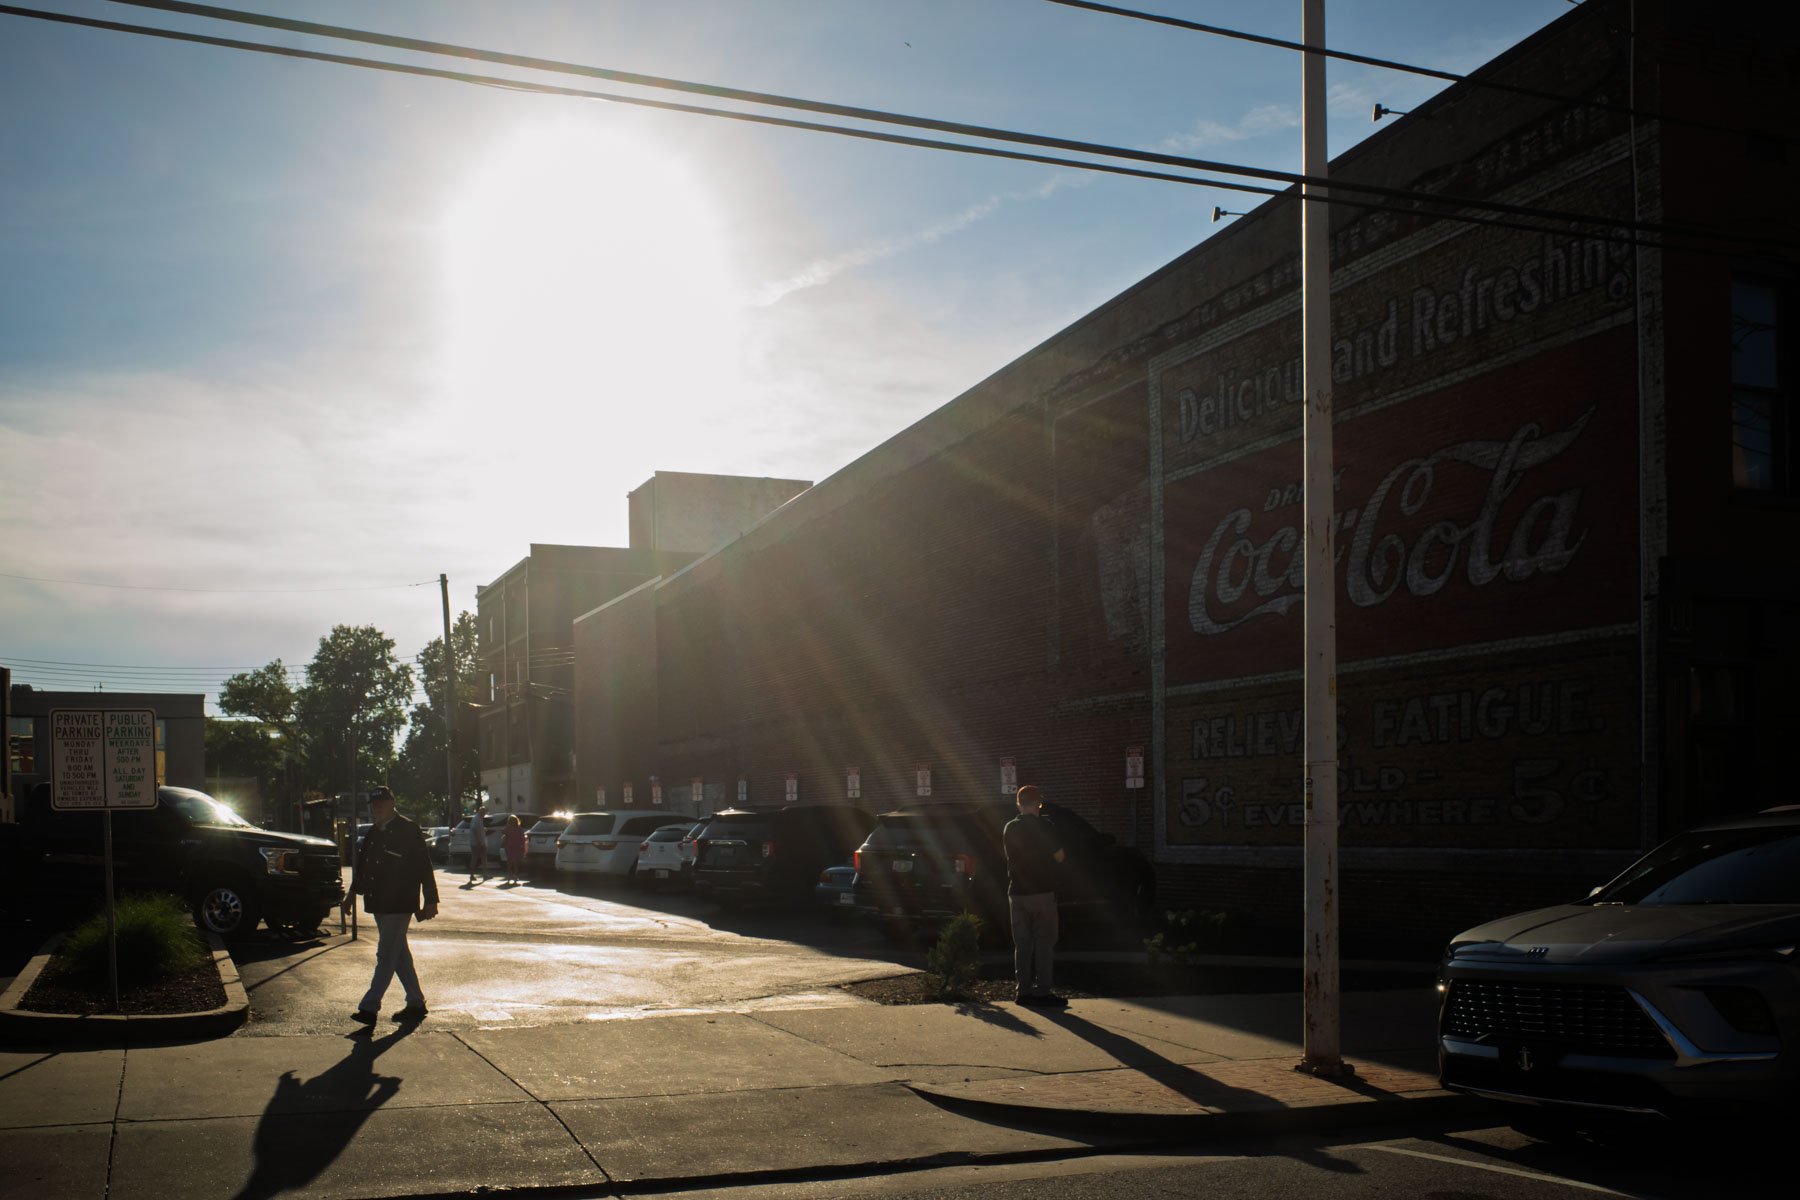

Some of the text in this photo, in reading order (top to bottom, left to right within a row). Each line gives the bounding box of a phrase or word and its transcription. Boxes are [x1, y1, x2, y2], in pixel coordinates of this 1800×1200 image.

[1332, 296, 1399, 386] and
[1411, 220, 1634, 358] Refreshing
[56, 714, 99, 726] PRIVATE
[110, 714, 147, 726] PUBLIC
[55, 727, 101, 738] PARKING
[106, 727, 151, 738] PARKING
[1192, 704, 1351, 760] RELIEVS
[113, 767, 146, 775] ALL DAY
[1244, 798, 1497, 828] EVEYWHERE
